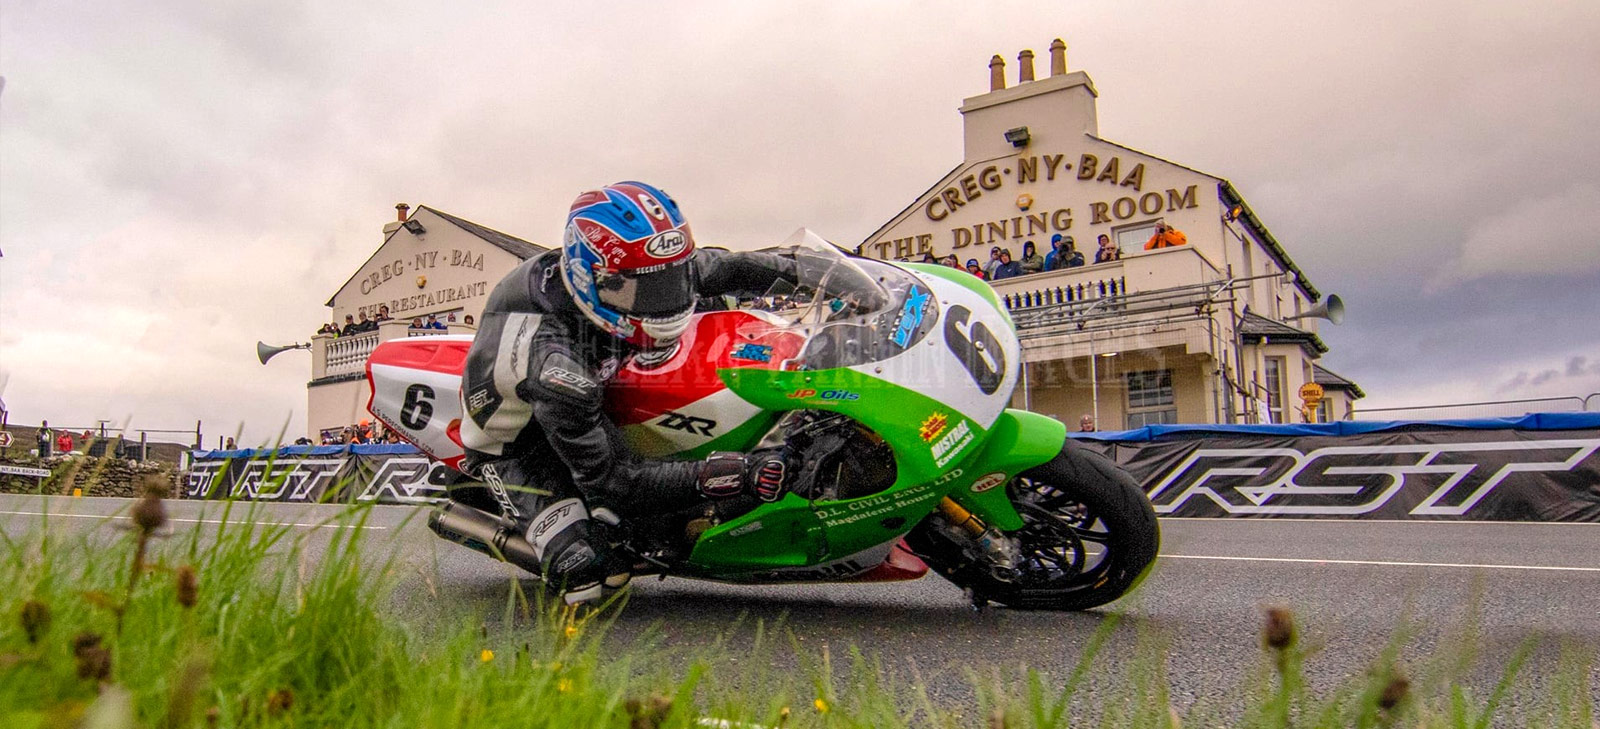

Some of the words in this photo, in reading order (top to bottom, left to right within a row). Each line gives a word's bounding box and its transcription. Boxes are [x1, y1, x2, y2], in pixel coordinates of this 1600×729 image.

[875, 232, 933, 261] THE
[951, 207, 1073, 249] DINING
[1089, 184, 1199, 225] ROOM
[390, 281, 487, 313] RESTAURANT
[944, 304, 1006, 395] 6
[544, 366, 597, 388] RST
[786, 389, 817, 399] JP
[820, 389, 860, 400] Oils
[1302, 389, 1321, 397] SHELL
[400, 383, 436, 431] 6
[931, 418, 970, 460] MISTRAL
[482, 463, 520, 517] RST
[848, 496, 890, 511] CIVIL
[934, 468, 963, 486] LTD
[976, 478, 1001, 491] HEL
[1146, 438, 1600, 516] RST
[824, 505, 894, 528] Magdalene
[895, 491, 936, 508] House
